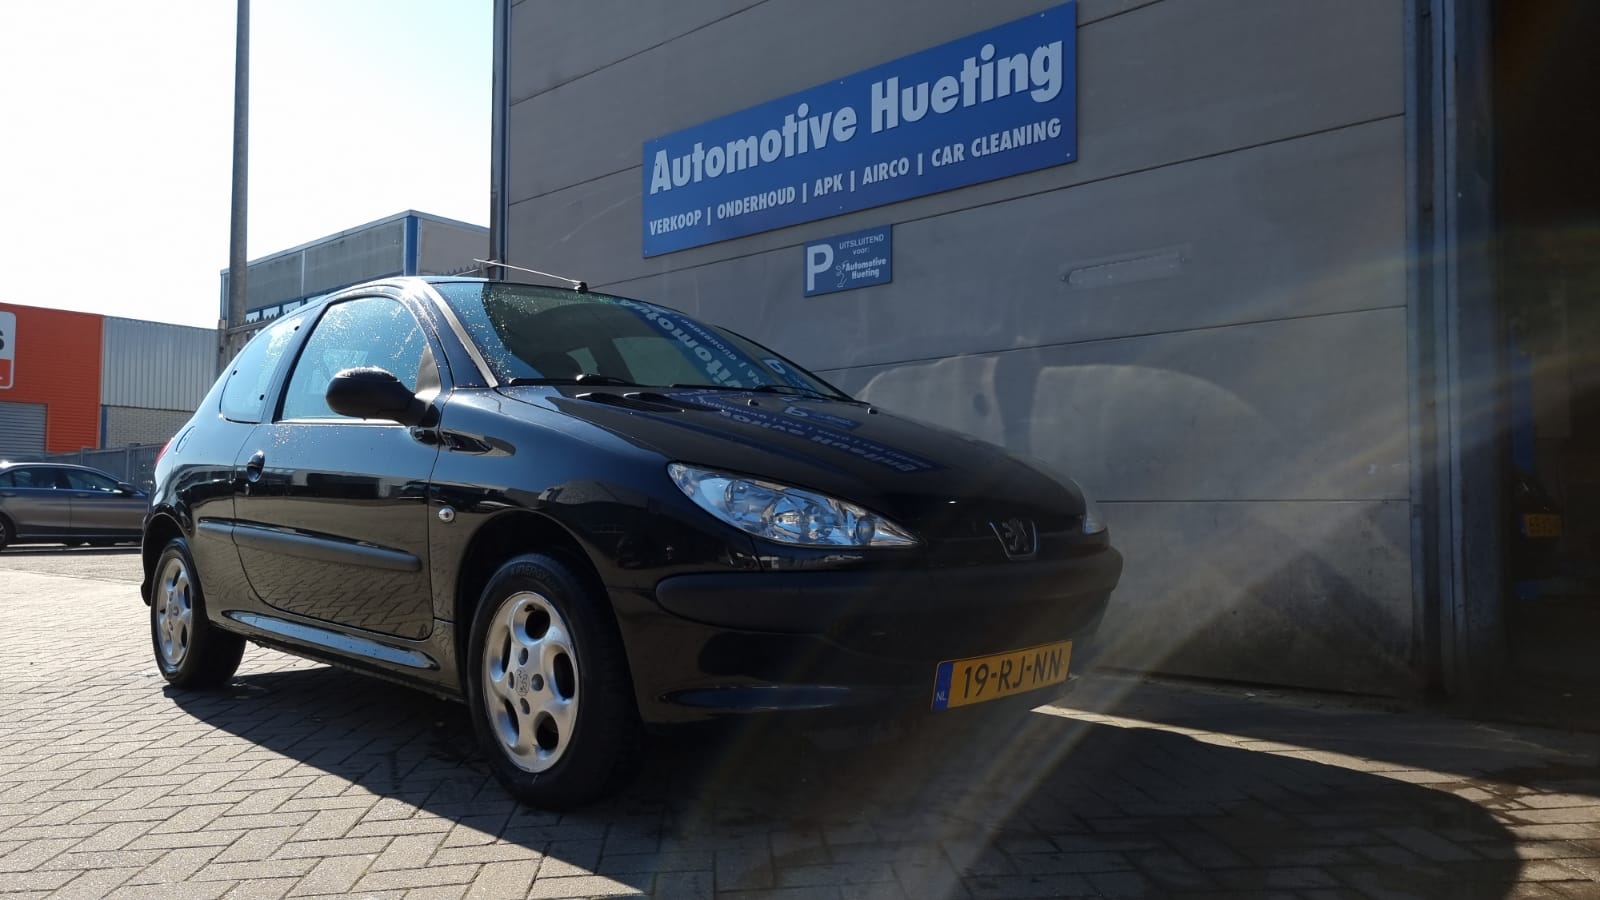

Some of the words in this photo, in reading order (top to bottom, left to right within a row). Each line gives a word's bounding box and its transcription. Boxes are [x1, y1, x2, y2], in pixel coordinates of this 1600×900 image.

[650, 103, 857, 195] Automotive
[871, 40, 1063, 134] Hueting
[649, 209, 702, 236] VERKOOP
[717, 186, 796, 220] ONDERHOUD
[814, 173, 844, 197] APK
[862, 157, 910, 185] AIRCO
[931, 143, 965, 167] CAR
[971, 117, 1062, 158] CLEANING
[839, 233, 885, 250] UITSLUITEND
[807, 243, 834, 291] P
[845, 257, 887, 272] Automotive
[851, 267, 880, 280] Hueting
[963, 648, 1063, 699] 19-RJ-NN
[936, 691, 946, 702] NL
